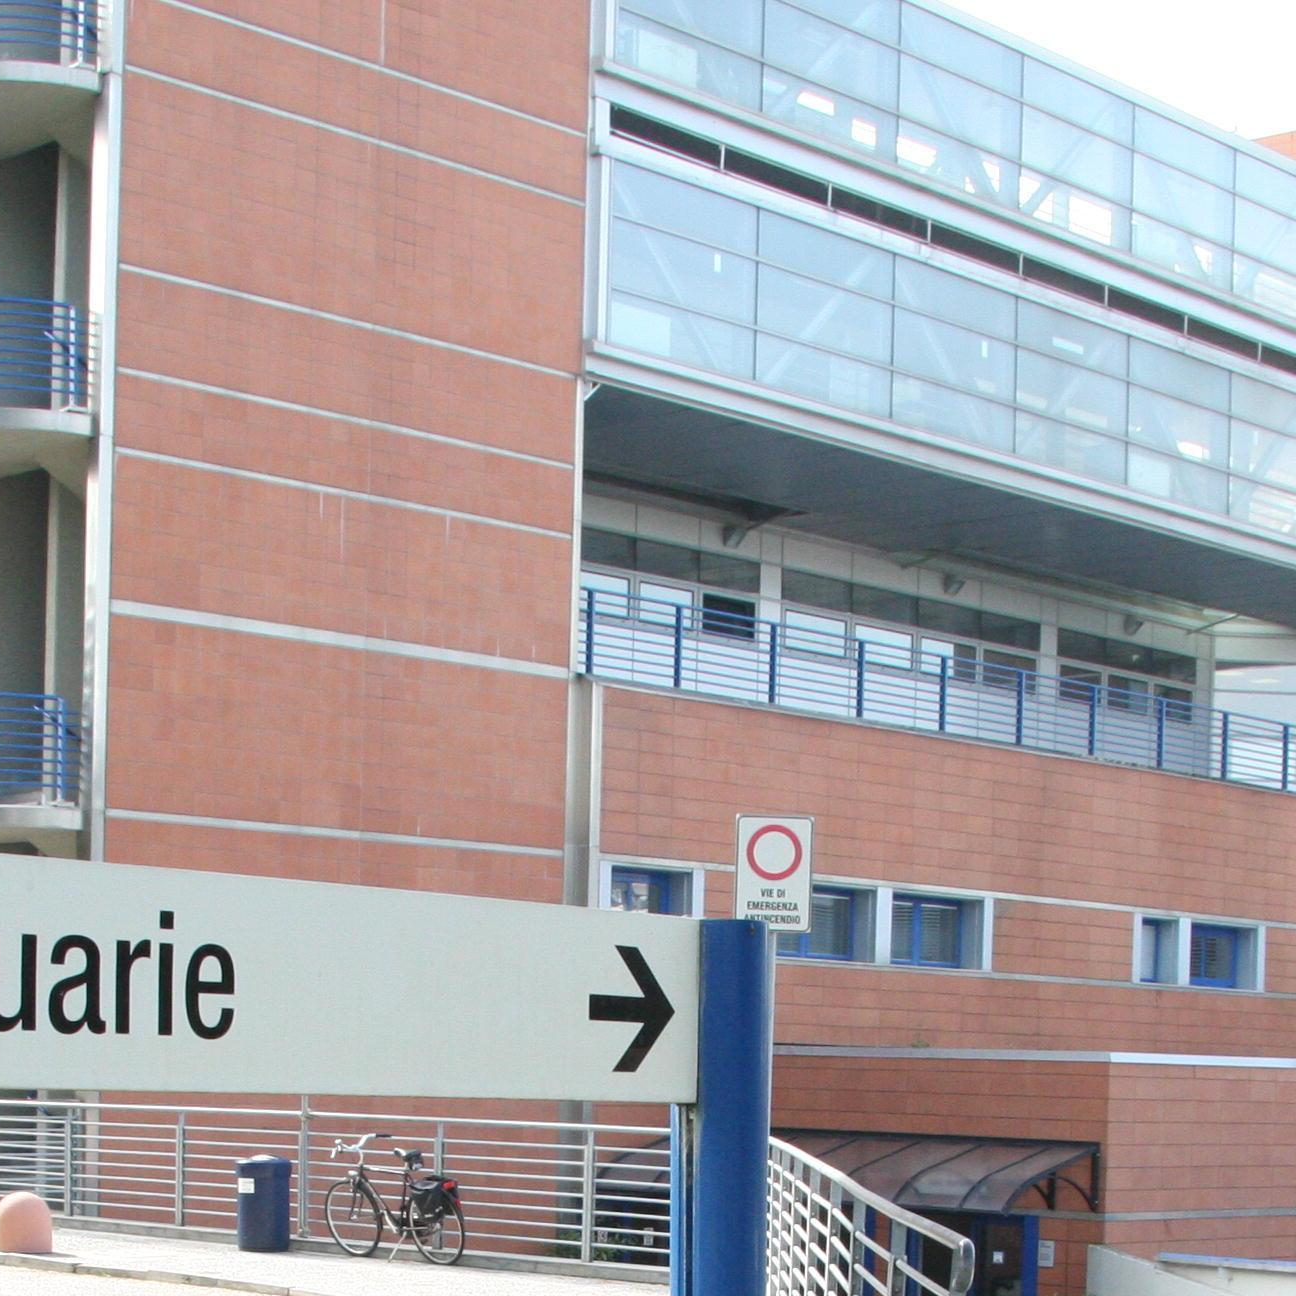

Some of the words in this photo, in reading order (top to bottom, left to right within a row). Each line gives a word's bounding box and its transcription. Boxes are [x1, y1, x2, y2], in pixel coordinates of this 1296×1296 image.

[760, 888, 774, 898] VIE
[776, 888, 786, 898] DI
[746, 901, 799, 912] EMERGENZA
